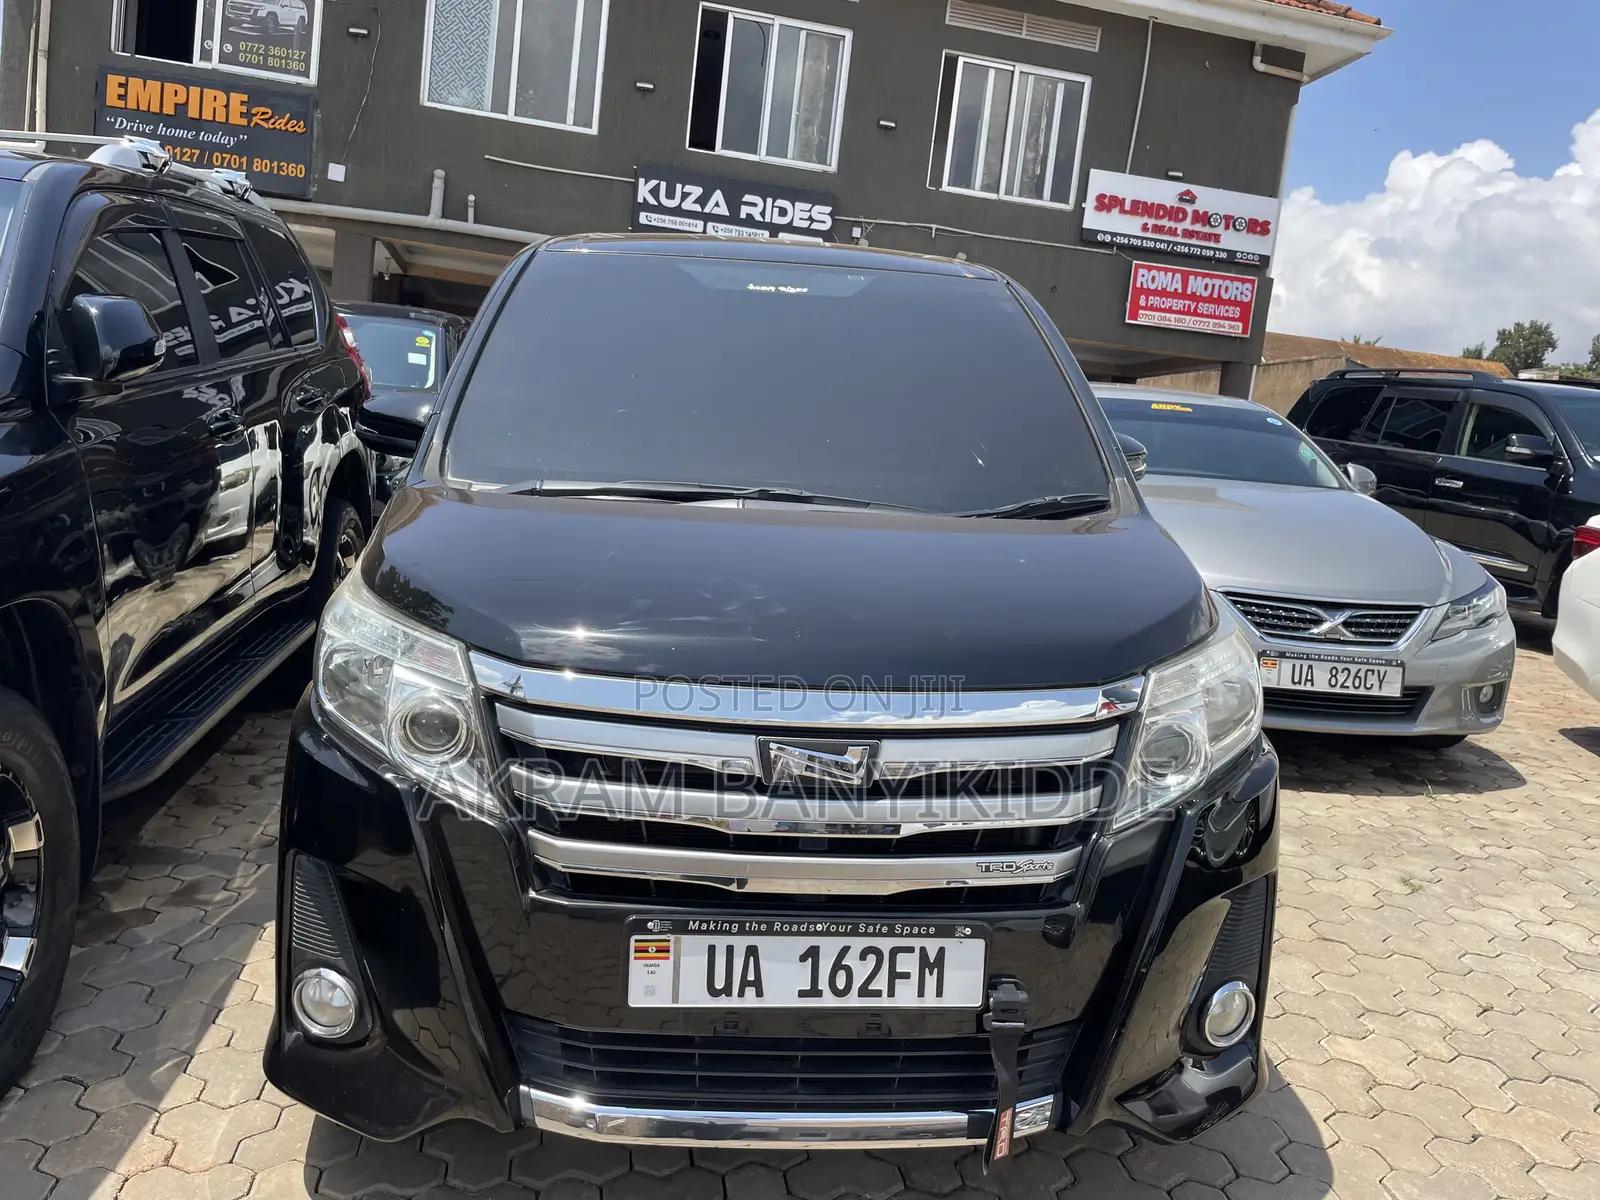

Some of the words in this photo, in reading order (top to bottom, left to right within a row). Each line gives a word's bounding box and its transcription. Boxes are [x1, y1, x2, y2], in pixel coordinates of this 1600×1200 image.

[239, 53, 264, 65] 0701
[268, 58, 306, 72] 801360
[240, 41, 265, 54] 0772
[268, 46, 306, 60] 360127
[106, 74, 249, 127] EMPIRE
[250, 106, 307, 134] Rides
[157, 123, 196, 140] home
[204, 150, 209, 164] /
[212, 152, 248, 170] 0701
[252, 158, 306, 178] 801360
[637, 177, 730, 216] KUZA
[740, 194, 833, 231] RIDES
[1094, 192, 1188, 223] SPLENDID
[1191, 210, 1272, 237] MOTORS
[1141, 222, 1150, 232] &
[1150, 224, 1180, 238] REAL
[1182, 226, 1222, 244] ESTATE
[1112, 235, 1129, 244] +256
[1130, 237, 1142, 246] 705
[1142, 238, 1155, 248] 530
[1174, 244, 1188, 254] +256
[1190, 246, 1200, 255] 772
[1202, 248, 1214, 257] 059
[1214, 250, 1228, 259] 330
[1136, 268, 1182, 294] ROMA
[1186, 275, 1252, 302] MOTORS
[1139, 295, 1146, 307] &
[1148, 296, 1196, 312] PROPERTY
[1197, 303, 1240, 318] SERVICES
[1138, 312, 1156, 321] 0701
[1157, 314, 1172, 323] 084
[1192, 319, 1210, 328] 0772
[1212, 321, 1226, 330] 894
[1227, 323, 1240, 331] 961
[1291, 663, 1314, 687] UA
[1328, 666, 1388, 691] 826CY
[688, 920, 739, 932] Making
[745, 922, 768, 932] the
[774, 922, 814, 932] Roads
[822, 922, 853, 933] Your
[858, 924, 888, 934] Safe
[894, 924, 936, 936] Space
[706, 944, 765, 999] UA
[797, 944, 946, 999] 162FM
